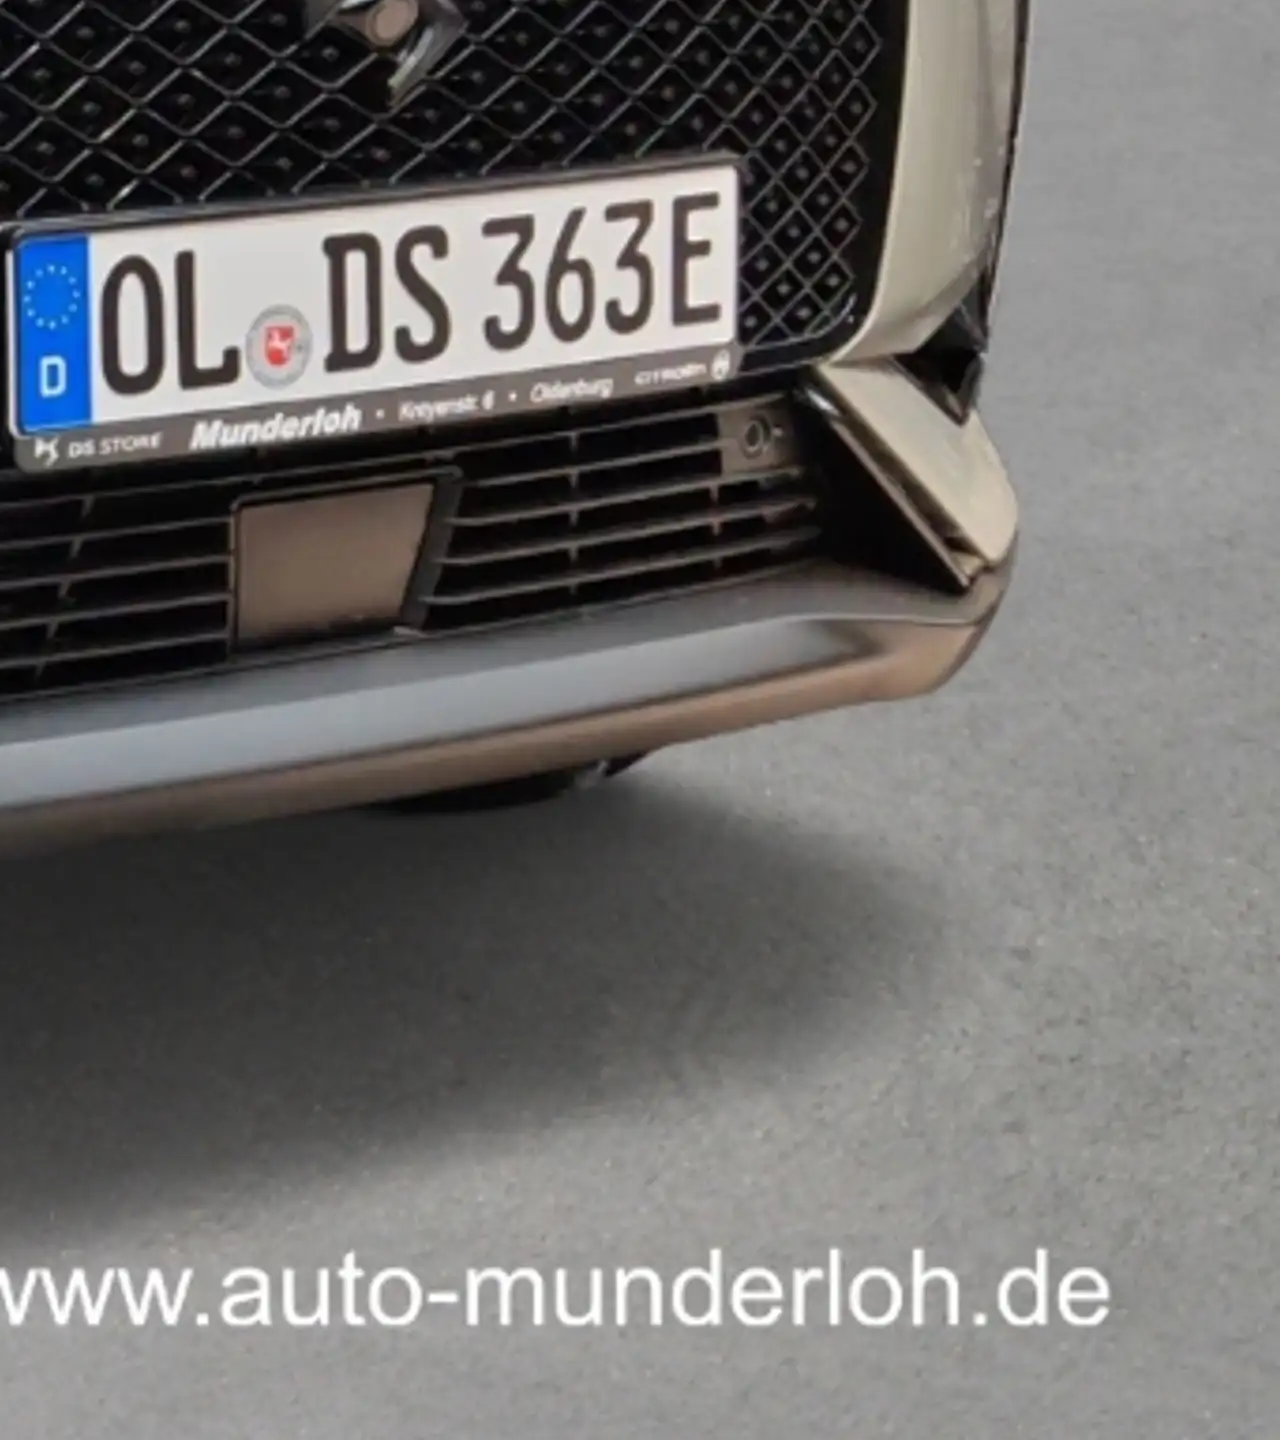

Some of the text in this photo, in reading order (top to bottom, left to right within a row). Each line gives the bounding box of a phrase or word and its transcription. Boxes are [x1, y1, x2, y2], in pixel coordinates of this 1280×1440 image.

[100, 194, 722, 396] OL DS 363E
[39, 355, 66, 397] D
[190, 406, 362, 451] Munderloh
